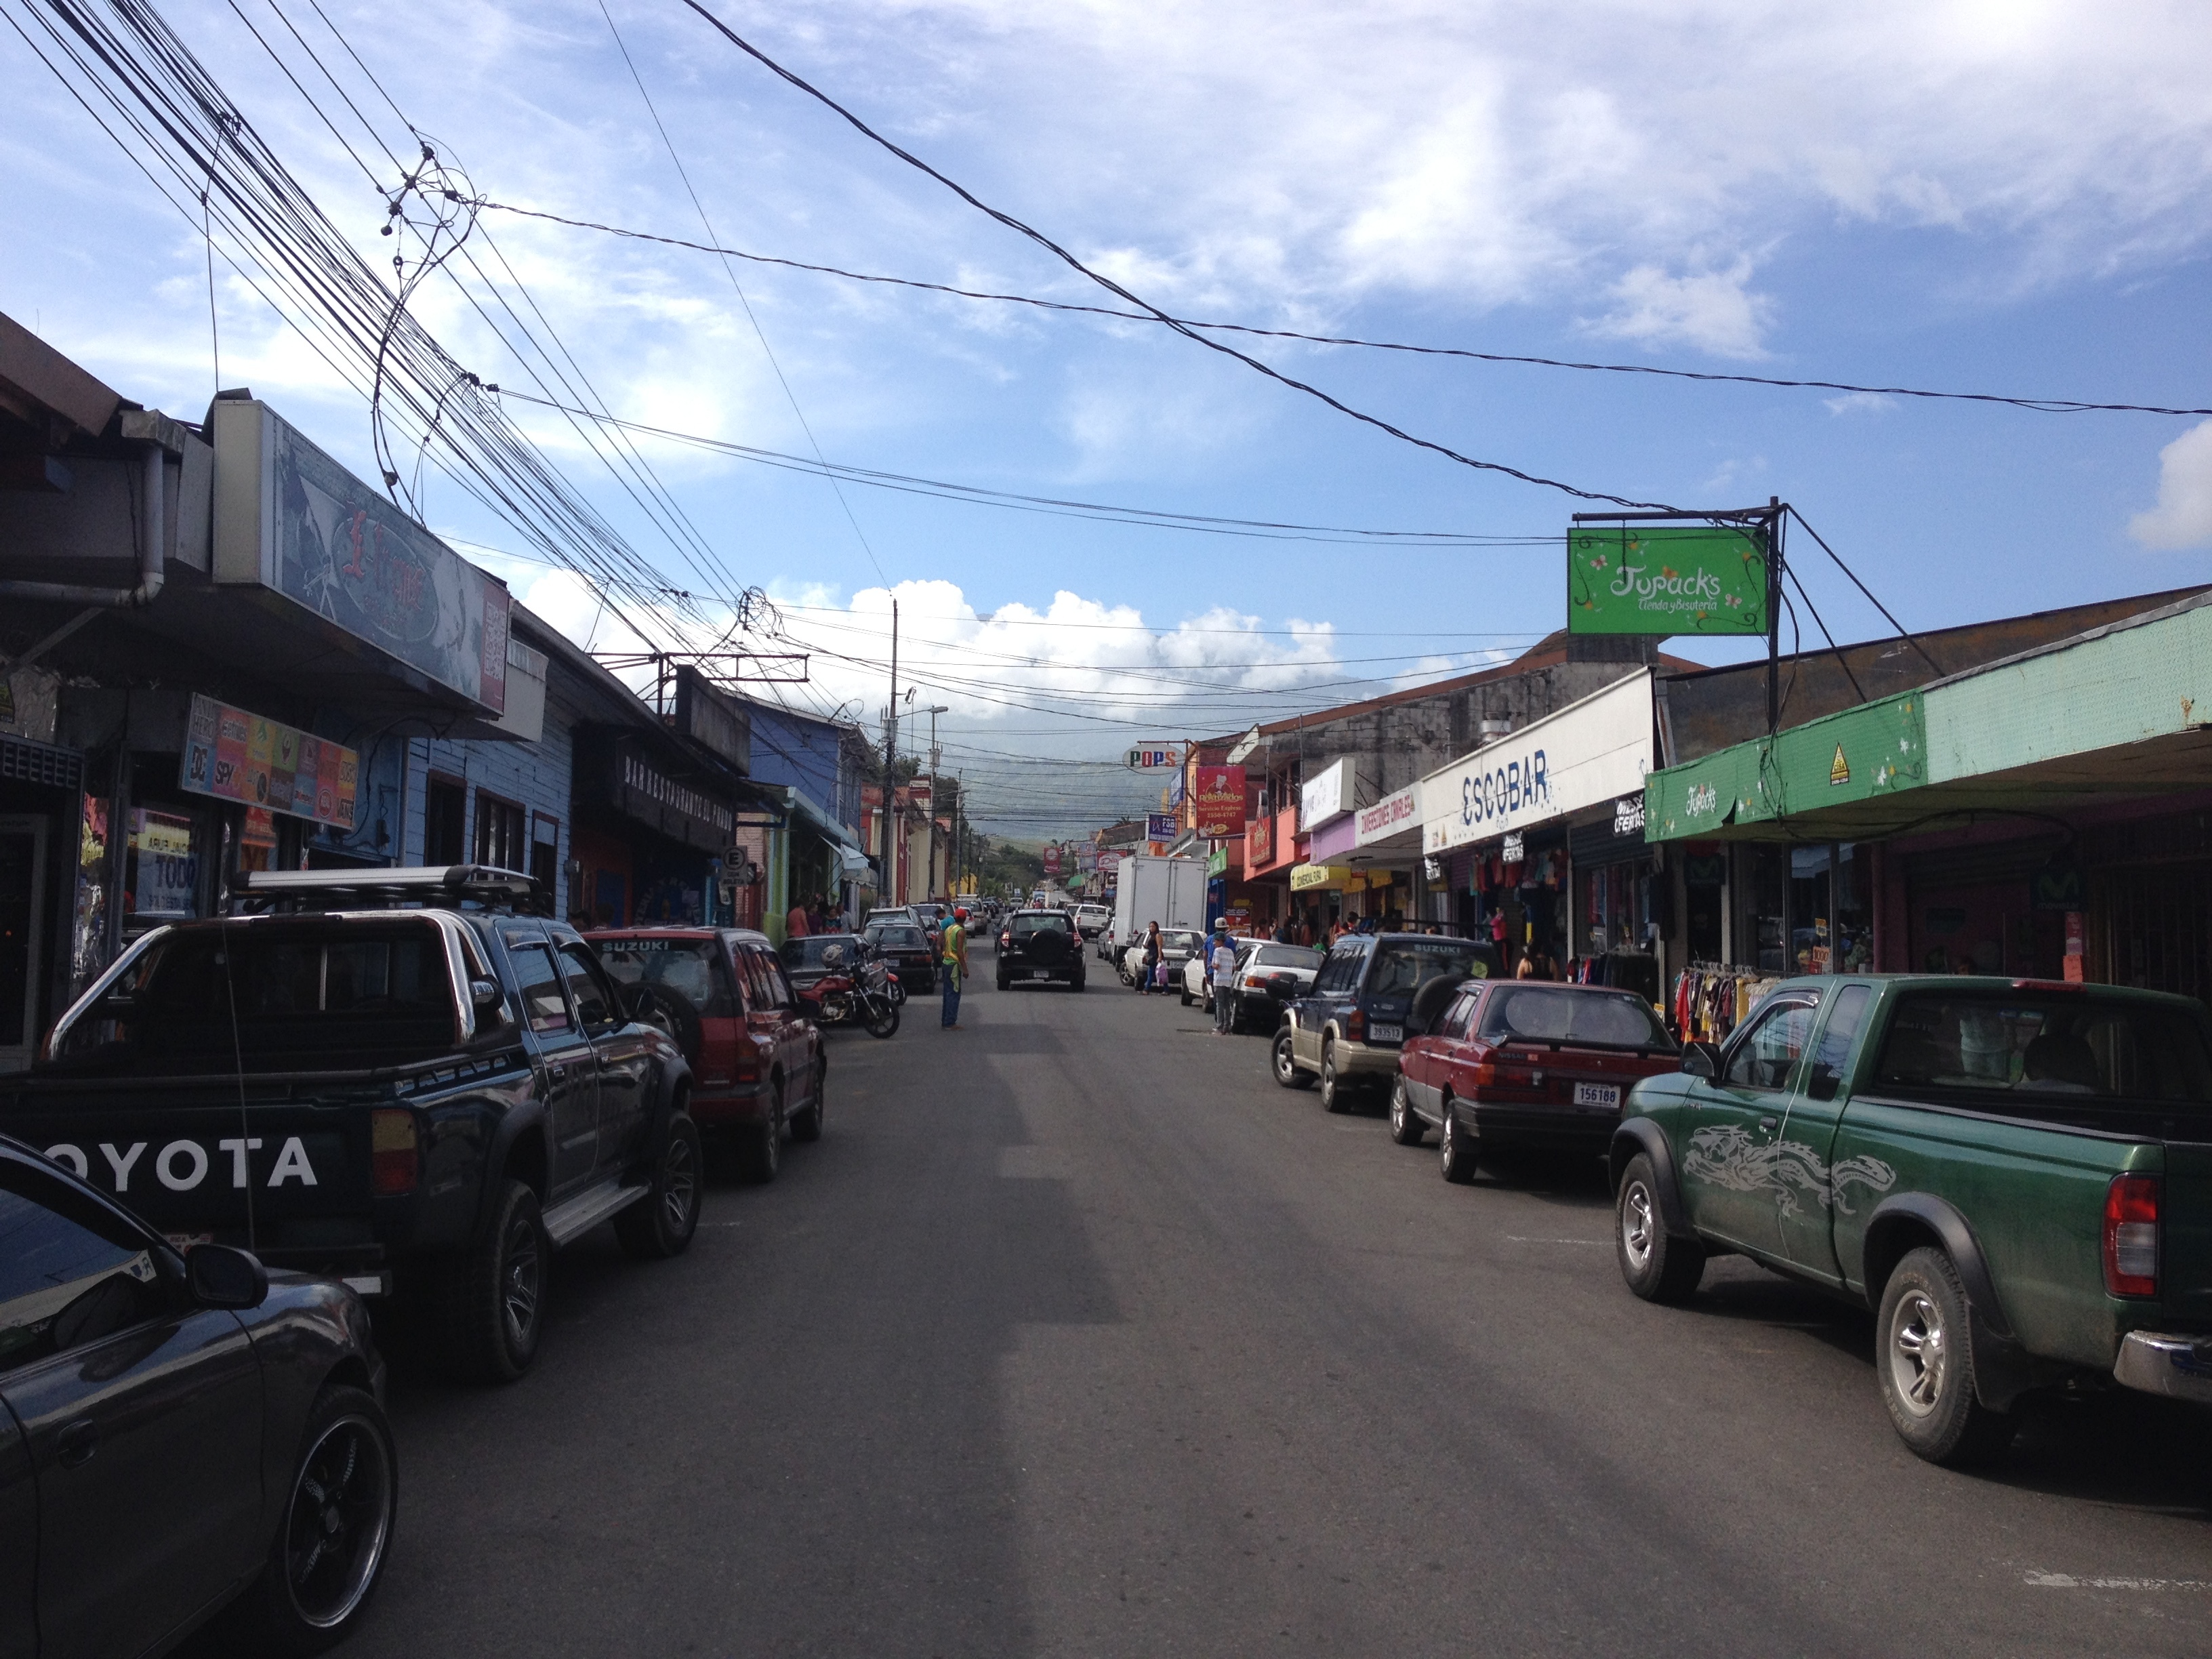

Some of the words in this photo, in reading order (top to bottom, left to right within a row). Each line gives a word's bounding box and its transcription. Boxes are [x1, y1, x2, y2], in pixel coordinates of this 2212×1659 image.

[1130, 751, 1176, 767] POPS
[215, 760, 234, 786] SPY
[624, 756, 644, 791] BAR
[1463, 749, 1547, 826] ESCOBAR
[729, 853, 739, 865] E
[602, 941, 669, 952] SUZUKI
[1414, 944, 1460, 954] SUZUKI
[1580, 1087, 1616, 1103] 156188
[43, 1136, 318, 1192] OYOTA
